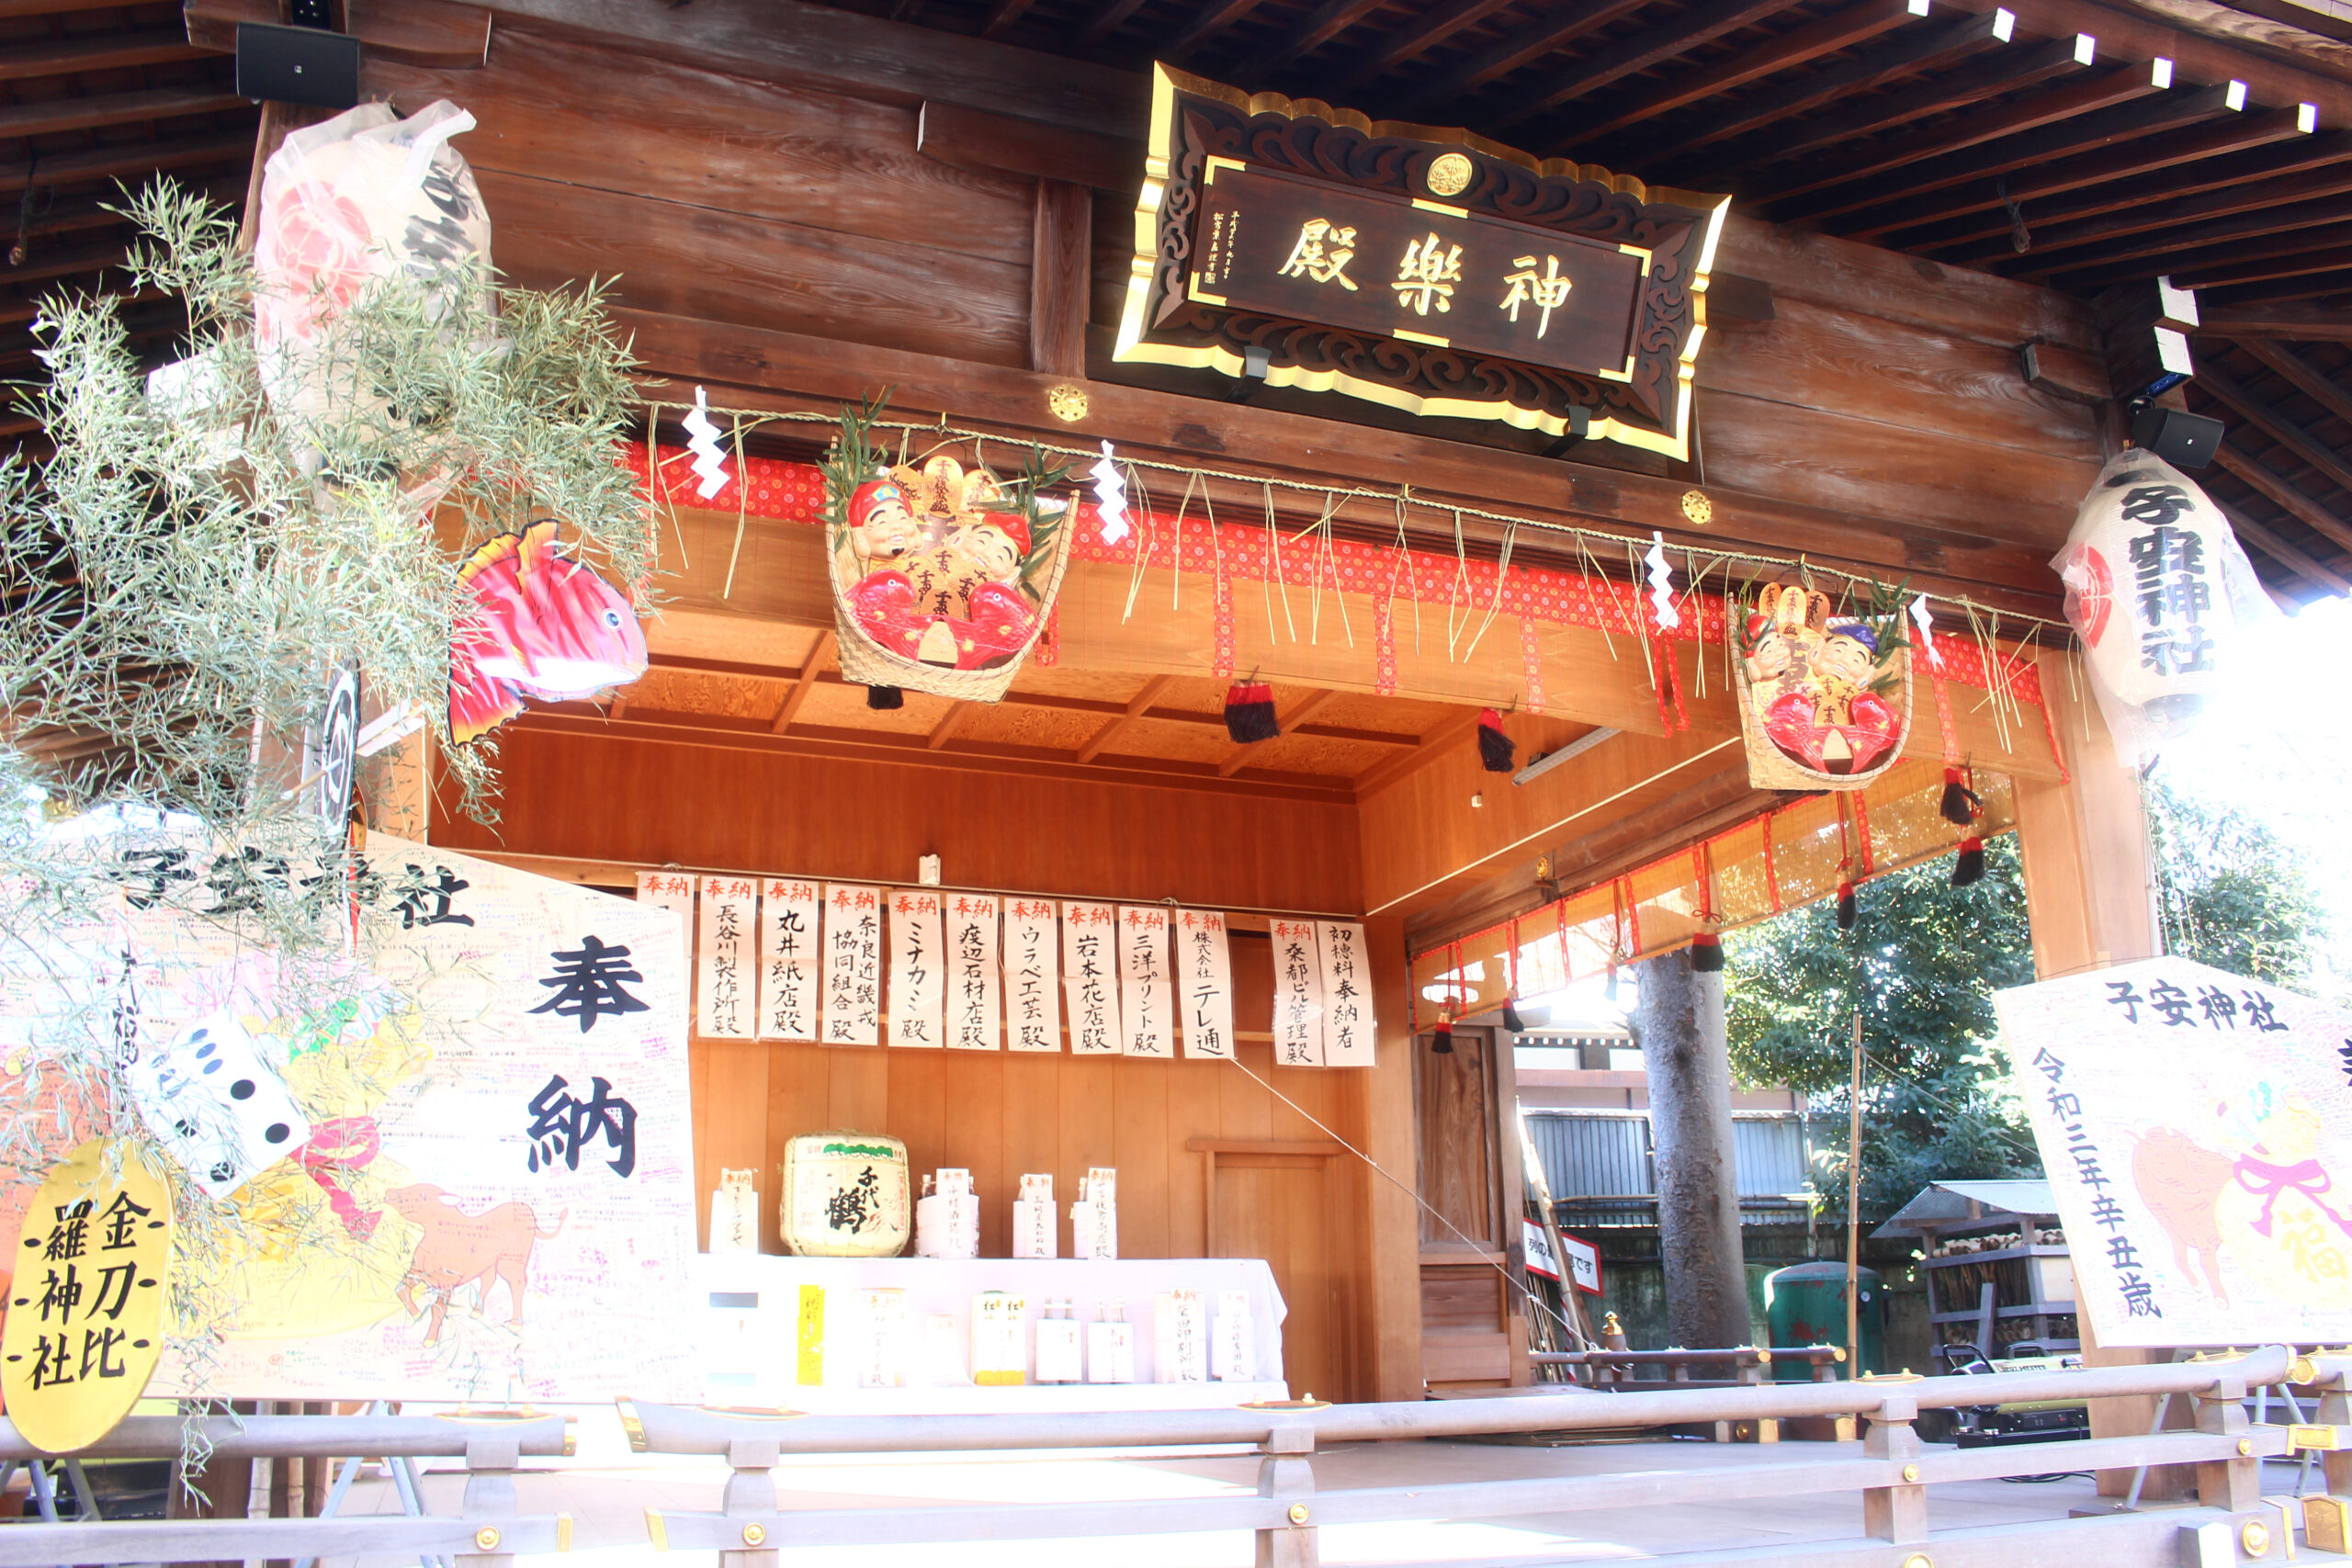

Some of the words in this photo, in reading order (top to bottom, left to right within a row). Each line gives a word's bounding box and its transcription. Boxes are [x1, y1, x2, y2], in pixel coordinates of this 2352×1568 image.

[1277, 219, 1573, 339] 神樂殿
[2120, 484, 2215, 677] 子安神社
[642, 876, 690, 897] 奉納
[705, 879, 752, 900] 奉納
[768, 881, 813, 903] 奉納
[831, 889, 876, 913] 奉納
[895, 896, 937, 917] 奉納
[954, 897, 993, 919] 奉納
[1012, 900, 1052, 922] 奉納
[1068, 905, 1111, 927] 奉納
[1123, 909, 1164, 931] 奉納
[1179, 912, 1222, 932] 奉納
[1274, 921, 1312, 942] 奉納
[712, 904, 741, 1034] 長谷川製作所殿
[772, 909, 805, 1034] 丸井紙店殿
[831, 930, 859, 1042] 協同組合殿
[901, 922, 930, 1042] ミナカミ殿
[1017, 926, 1050, 1047] ウラベ工芸殿
[1076, 934, 1112, 1050] 岩本花店殿
[1131, 934, 1160, 1054] 三洋プリント殿
[1284, 942, 1313, 1064] 桑都ビル管理殿
[1329, 926, 1360, 1049] 初穂料奉納者
[2105, 979, 2290, 1032] 子安神社
[526, 935, 651, 1179] 奉納
[2032, 1047, 2163, 1319] 令和三年辛丑歳
[24, 1199, 93, 1391] 羅神社
[79, 1190, 152, 1381] 金刀比
